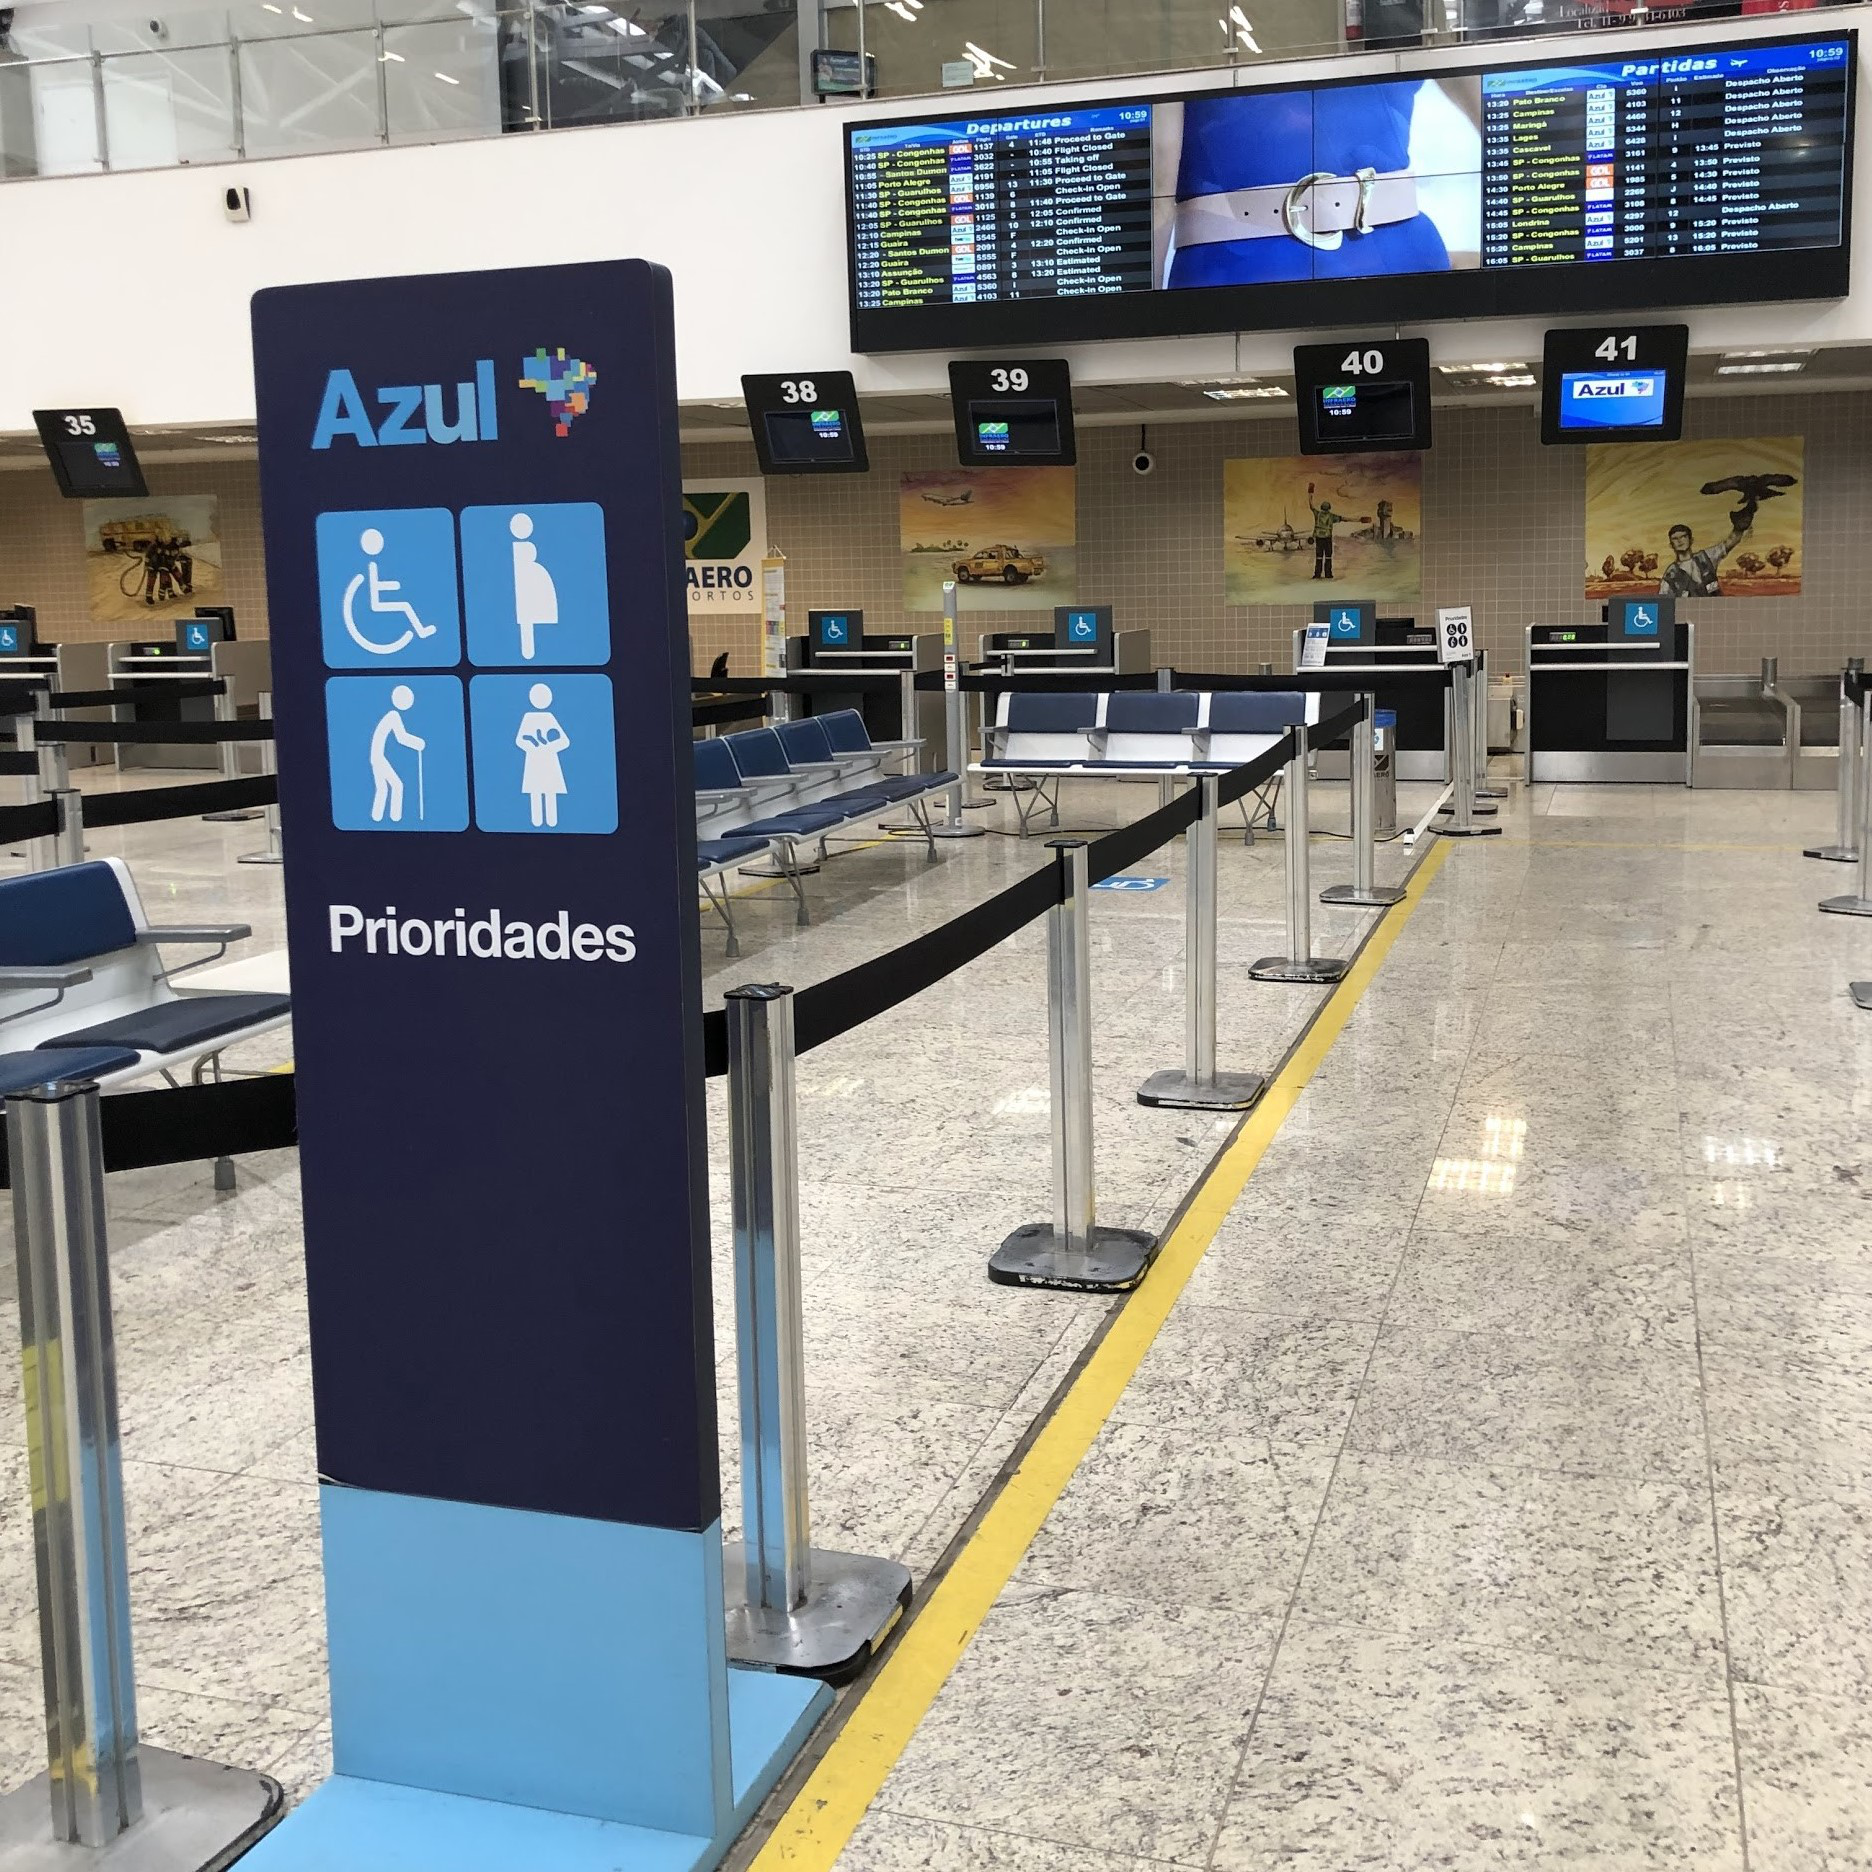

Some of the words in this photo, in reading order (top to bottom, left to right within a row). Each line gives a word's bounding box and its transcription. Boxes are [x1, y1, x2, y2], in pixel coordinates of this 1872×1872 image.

[1808, 47, 1844, 58] 10:59
[1621, 58, 1718, 77] Partidas
[1533, 96, 1565, 104] Branco
[1725, 77, 1771, 87] Despacho
[1772, 74, 1804, 83] Aberto
[1512, 109, 1555, 117] Campinas
[1724, 90, 1770, 99] Despacho
[1771, 87, 1803, 95] Aberto
[1724, 102, 1770, 112] Despacho
[1771, 99, 1803, 108] Aberto
[966, 116, 1072, 135] Departures
[1118, 110, 1148, 120] 10:59
[1512, 134, 1538, 142] Lages
[1724, 114, 1769, 124] Despacho
[1770, 112, 1802, 120] Aberto
[853, 152, 876, 161] 10:25
[877, 151, 890, 159] SP
[896, 147, 945, 157] Congonhas
[1053, 134, 1091, 144] Proceed
[1103, 131, 1125, 139] Gate
[1512, 144, 1551, 153] Cascavel
[1723, 127, 1769, 137] Despacho
[1770, 124, 1802, 133] Aberto
[854, 162, 876, 170] 10:40
[877, 161, 890, 169] SP
[896, 157, 945, 167] Congonhas
[1028, 147, 1052, 156] 10:40
[1054, 145, 1080, 154] Flight
[1081, 142, 1113, 152] Closed
[1512, 158, 1524, 166] SP
[1531, 155, 1580, 164] Congonhas
[1723, 140, 1761, 149] Previsto
[854, 172, 877, 180] 10:55
[885, 170, 914, 178] Santos
[916, 167, 947, 175] Dumon
[1028, 157, 1052, 166] 10:55
[1054, 155, 1085, 164] Taking
[1086, 153, 1099, 161] off
[854, 181, 877, 190] 11:05
[878, 180, 901, 188] Porto
[902, 179, 931, 187] Alegre
[1029, 167, 1053, 176] 11:05
[1054, 165, 1080, 175] Flight
[1081, 162, 1113, 172] Closed
[1512, 172, 1524, 180] SP
[1531, 169, 1580, 178] Congonhas
[1722, 155, 1760, 164] Previsto
[855, 191, 877, 200] 11:30
[878, 190, 890, 198] SP
[897, 187, 941, 197] Guarulhos
[1029, 177, 1053, 186] 11:30
[1054, 174, 1091, 184] Proceed
[1104, 172, 1126, 180] Gate
[1530, 193, 1575, 202] Guarulhos
[1721, 180, 1760, 188] Previsto
[1537, 182, 1565, 190] Alegre
[1722, 168, 1760, 176] Previsto
[855, 201, 878, 209] 11:40
[878, 200, 891, 208] SP
[897, 197, 946, 206] Congonhas
[1054, 184, 1094, 194] Check-in
[1095, 183, 1120, 192] Open
[855, 211, 878, 219] 11:40
[878, 210, 891, 218] SP
[897, 206, 946, 216] Congonhas
[1029, 197, 1053, 206] 11:40
[1055, 194, 1092, 204] Proceed
[1104, 192, 1126, 200] Gate
[1530, 205, 1580, 214] Congonhas
[1721, 192, 1759, 201] Previsto
[856, 222, 878, 230] 12:05
[898, 218, 943, 227] Guarulhos
[1030, 209, 1053, 217] 12:05
[1055, 205, 1101, 215] Confirmed
[1511, 219, 1550, 227] Londrina
[1721, 204, 1766, 213] Despacho
[1767, 202, 1799, 210] Aberto
[856, 231, 879, 240] 12:10
[879, 229, 922, 238] Campinas
[1030, 218, 1053, 227] 12:10
[1055, 215, 1102, 225] Confirmed
[856, 241, 879, 249] 12:15
[1055, 226, 1095, 235] Check-in
[1096, 225, 1121, 233] Open
[1530, 229, 1579, 238] Congonhas
[1721, 217, 1759, 225] Previsto
[857, 250, 879, 259] 12:20
[887, 249, 917, 257] Santos
[918, 247, 949, 255] Dumon
[1030, 238, 1054, 247] 12:20
[1055, 235, 1102, 245] Confirmed
[1511, 243, 1553, 251] Campinas
[1720, 229, 1759, 237] Previsto
[1530, 253, 1575, 262] Guarulhos
[1720, 242, 1758, 250] Previsto
[857, 261, 879, 269] 12:20
[1055, 246, 1095, 255] Check-in
[1096, 245, 1121, 253] Open
[857, 270, 880, 278] 13:10
[1030, 258, 1054, 267] 13:10
[1056, 255, 1100, 265] Estimated
[858, 280, 880, 288] 13:20
[881, 279, 893, 287] SP
[900, 277, 944, 285] Guarulhos
[1031, 268, 1054, 277] 13:20
[1056, 265, 1101, 275] Estimated
[858, 289, 880, 297] 13:20
[902, 287, 933, 295] Branco
[1056, 276, 1096, 285] Check-in
[1097, 275, 1122, 283] Open
[858, 299, 881, 307] 13:25
[881, 298, 923, 306] Campinas
[1056, 286, 1096, 295] Check-in
[1097, 285, 1122, 293] Open
[1594, 335, 1638, 362] 41
[1340, 350, 1384, 375] 40
[780, 380, 818, 404] 38
[990, 368, 1029, 392] 39
[1577, 382, 1626, 397] Azul
[311, 359, 498, 449] Azul
[64, 415, 97, 436] 35
[686, 565, 753, 588] AERO
[691, 590, 754, 602] ORTOS
[329, 904, 637, 964] Prioridades
